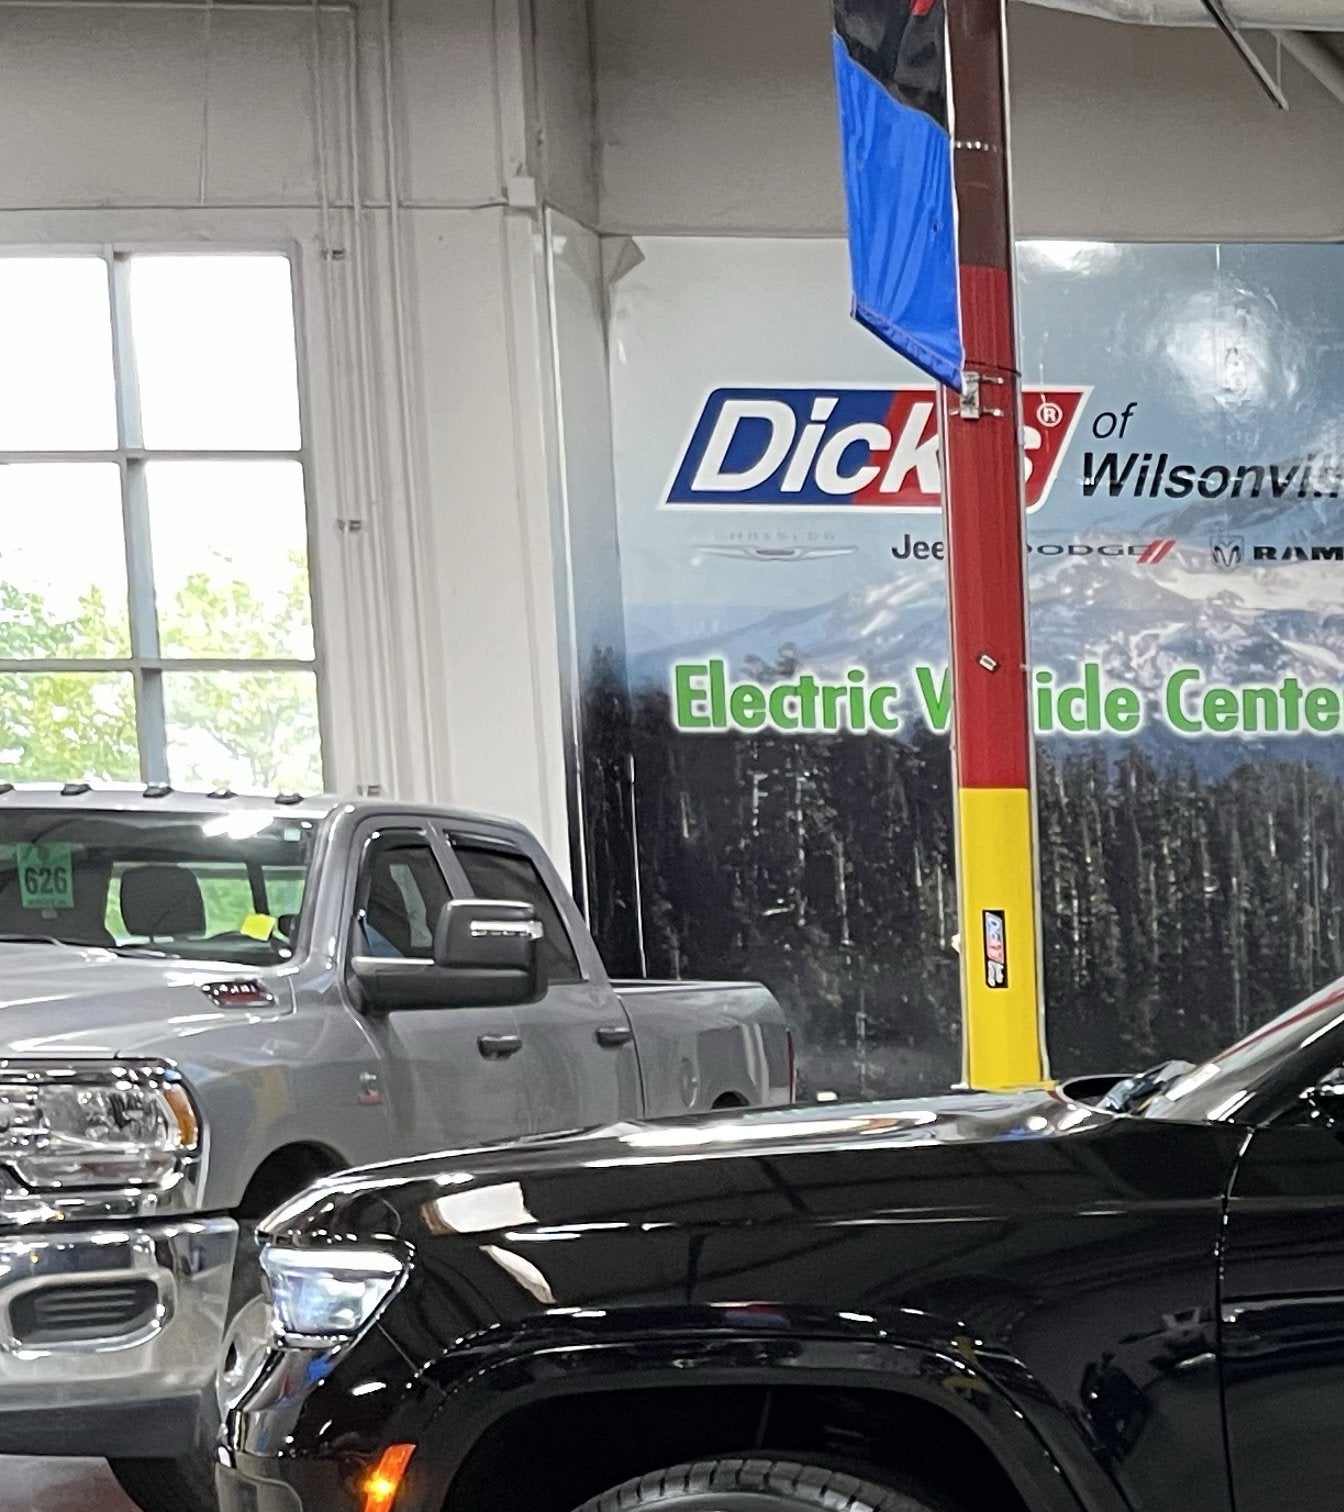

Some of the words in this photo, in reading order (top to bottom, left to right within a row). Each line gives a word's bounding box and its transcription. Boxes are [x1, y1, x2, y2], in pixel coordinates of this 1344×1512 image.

[1092, 402, 1137, 439] of
[690, 397, 1042, 495] Dick
[891, 533, 945, 561] Jee
[1026, 543, 1150, 556] ODGE
[1253, 546, 1344, 561] RAM
[675, 659, 900, 730] Electric
[916, 662, 1140, 731] Vicle
[25, 866, 68, 895] 626
